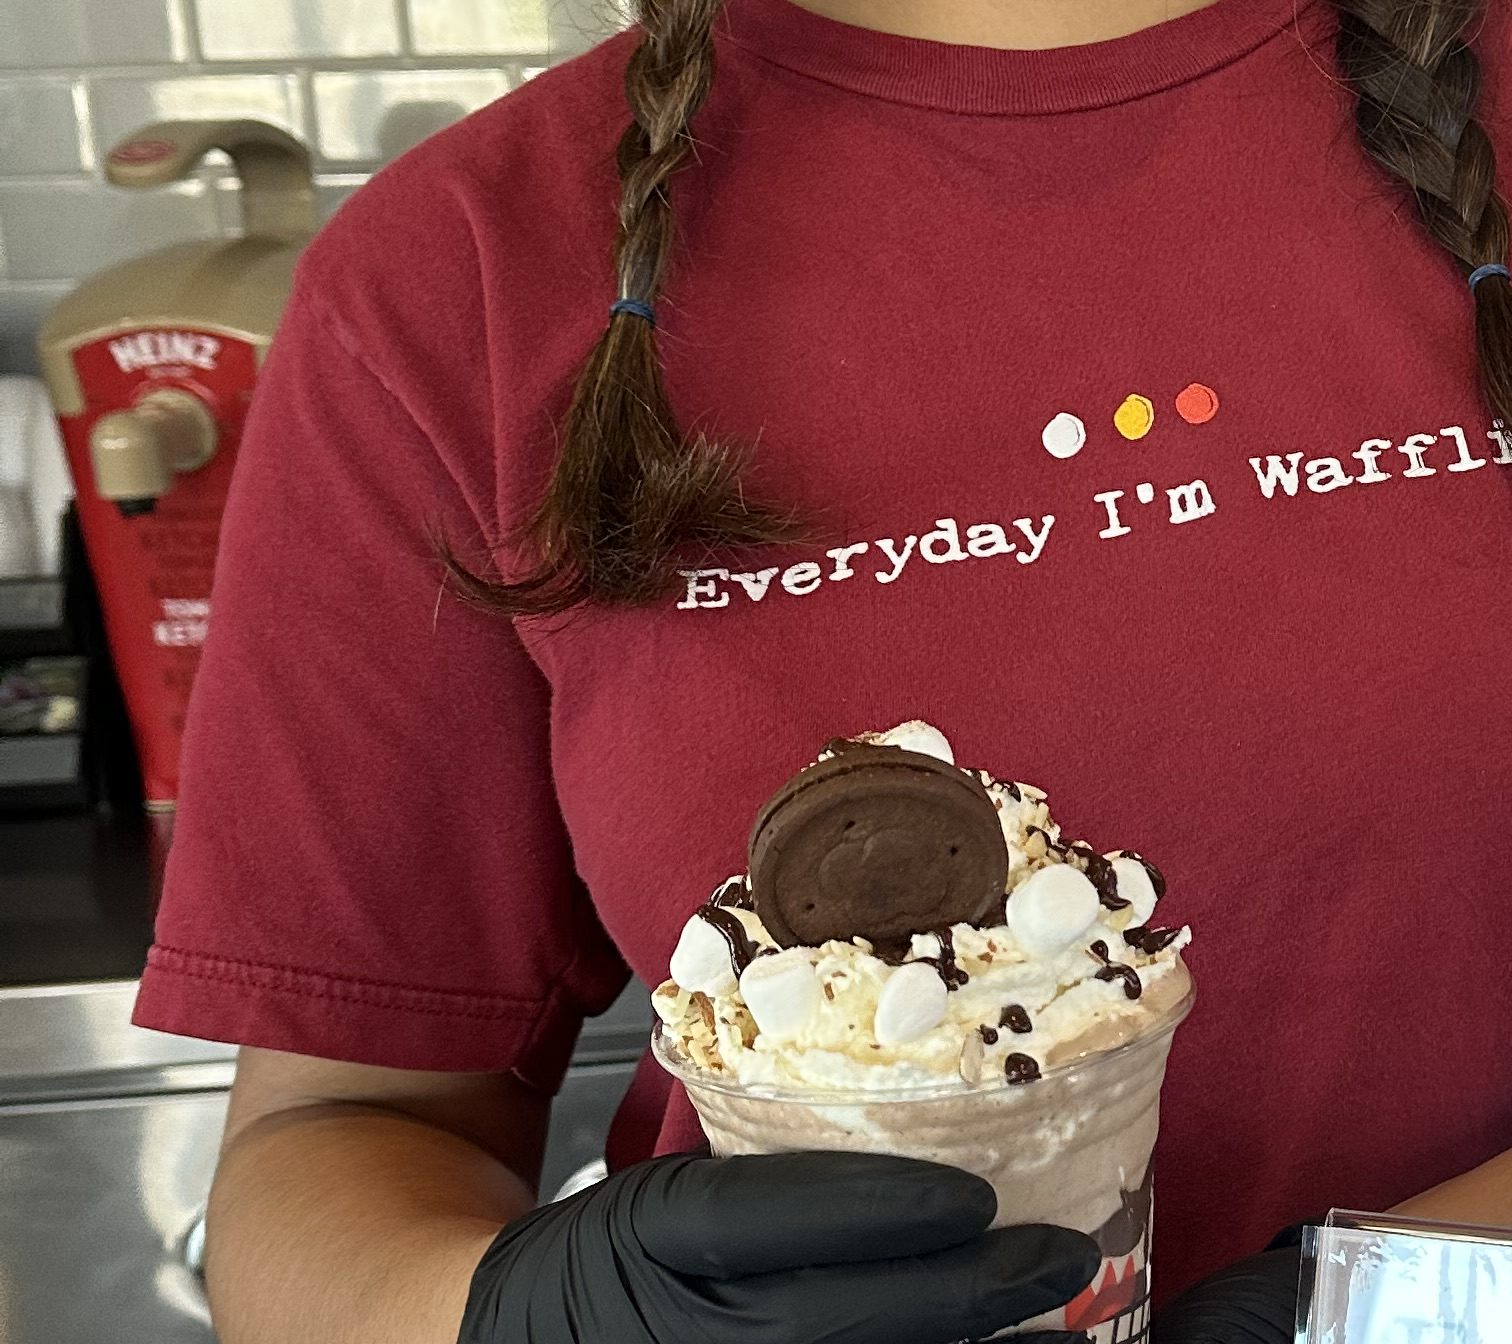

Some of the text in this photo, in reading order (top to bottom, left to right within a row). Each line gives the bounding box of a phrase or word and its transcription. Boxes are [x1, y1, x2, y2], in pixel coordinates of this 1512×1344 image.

[108, 331, 222, 374] HEINZ
[676, 514, 1056, 610] Everyday
[1093, 479, 1217, 540] I'm
